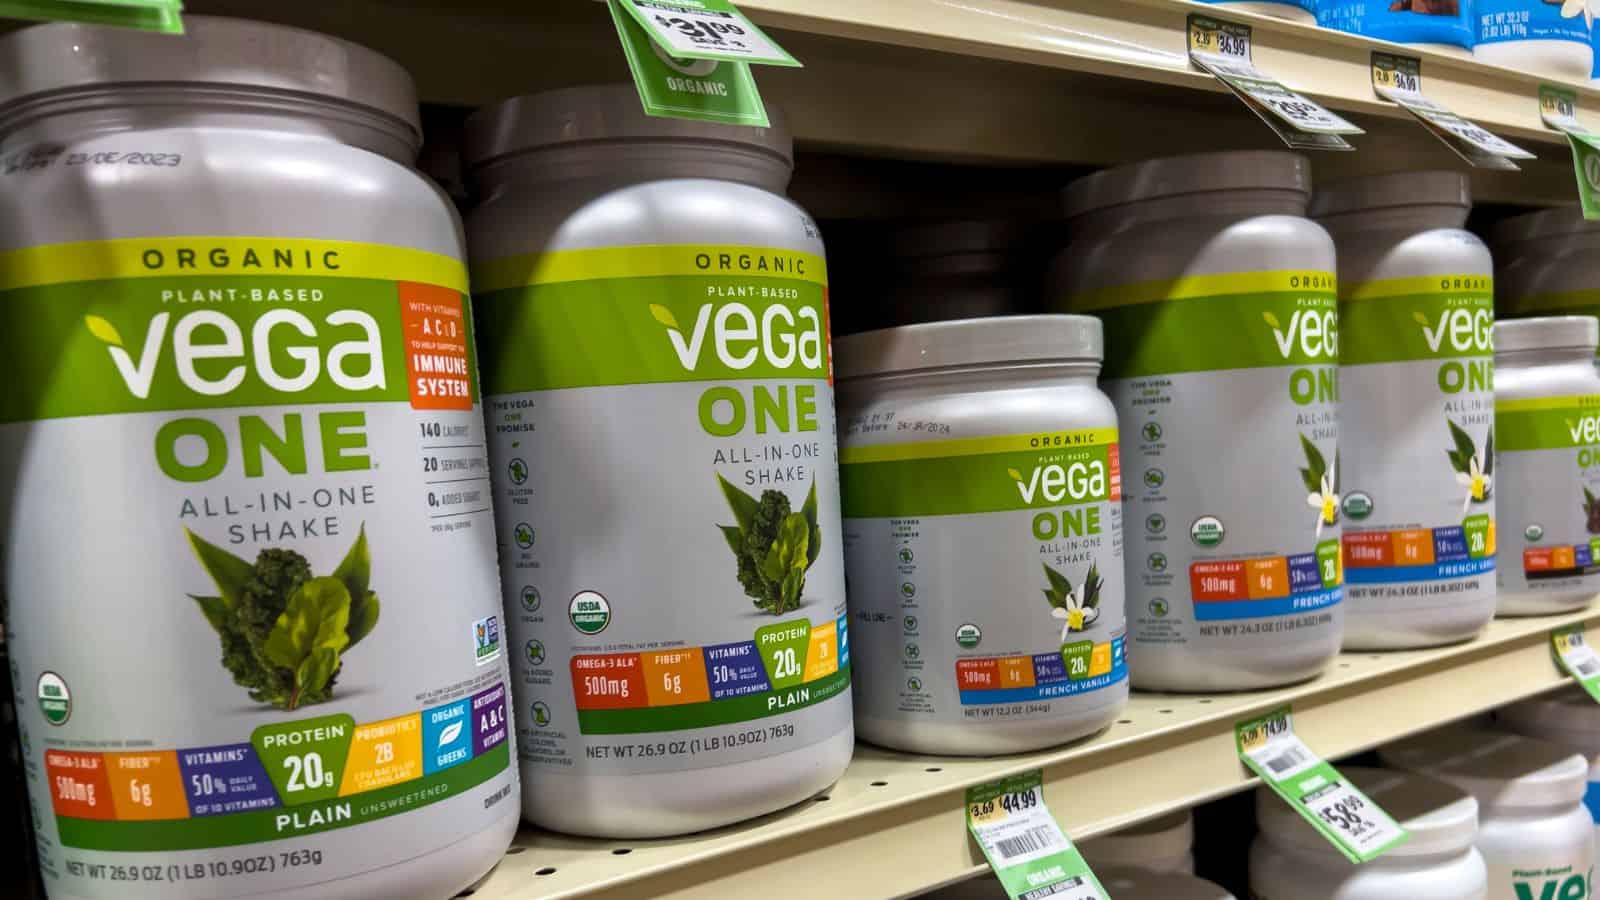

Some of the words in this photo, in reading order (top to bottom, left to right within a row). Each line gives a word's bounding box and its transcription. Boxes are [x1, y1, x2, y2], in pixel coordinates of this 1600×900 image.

[666, 76, 728, 97] ORGANIC
[142, 248, 341, 270] ORGANIC
[695, 253, 805, 275] ORGANIC
[161, 288, 324, 303] PLANT-BASED
[707, 286, 798, 299] PLANT-BASED
[413, 353, 467, 375] IMMUNE
[417, 377, 468, 398] SYSTEM
[510, 400, 534, 409] VEGA
[698, 384, 818, 437] ONE
[420, 422, 441, 438] 140
[1030, 433, 1095, 447] ORGANIC
[155, 411, 371, 482] ONE
[713, 442, 819, 465] ALL-IN-ONE
[424, 457, 438, 473] 20
[745, 466, 804, 486] SHAKE
[179, 485, 375, 518] ALL-IN-ONE
[228, 517, 340, 544] SHAKE
[1032, 507, 1102, 541] ONE
[1040, 537, 1101, 554] ALL-IN-ONE
[1056, 552, 1091, 566] SHAKE
[1438, 562, 1476, 577] FRENCH
[1369, 586, 1384, 597] WT
[578, 601, 601, 611] USDA
[762, 626, 807, 646] PROTEIN
[1222, 625, 1238, 635] WT
[655, 654, 681, 665] FIBER
[709, 647, 750, 660] VITAMINS
[1064, 645, 1090, 655] PROTEIN
[576, 659, 614, 670] OMEGA-3
[617, 657, 634, 668] ALA
[663, 672, 681, 694] 6g
[713, 665, 737, 684] 50%
[585, 676, 628, 697] 500mg
[735, 683, 769, 696] VITAMINS
[1039, 683, 1078, 696] FRENCH
[1081, 676, 1110, 689] VANILLA
[767, 688, 810, 711] PLAIN
[432, 704, 464, 724] ORGANIC
[965, 708, 980, 718] NET
[982, 708, 995, 717] WT
[481, 714, 488, 734] A
[263, 725, 345, 749] PROTEIN
[586, 746, 610, 759] NET
[613, 744, 634, 758] WT
[638, 743, 665, 757] 26.9
[669, 741, 687, 754] OZ
[690, 739, 700, 755] (1
[704, 737, 720, 750] LB
[723, 729, 767, 748] 10.9OZ)
[769, 724, 795, 740] 763g
[185, 749, 244, 766] VITAMINS
[437, 747, 466, 767] GREENS
[130, 779, 152, 806] 6g
[192, 773, 226, 797] 50%
[276, 803, 351, 832] PLAIN
[361, 784, 448, 816] UNSWEETENED
[999, 790, 1037, 813] $44.99
[89, 864, 106, 879] WT
[110, 864, 138, 881] 26.9
[142, 865, 163, 881] OZ
[167, 865, 180, 883] (1
[185, 863, 205, 879] LB
[210, 855, 275, 878] 10.9OZ)
[279, 850, 322, 869] 763g
